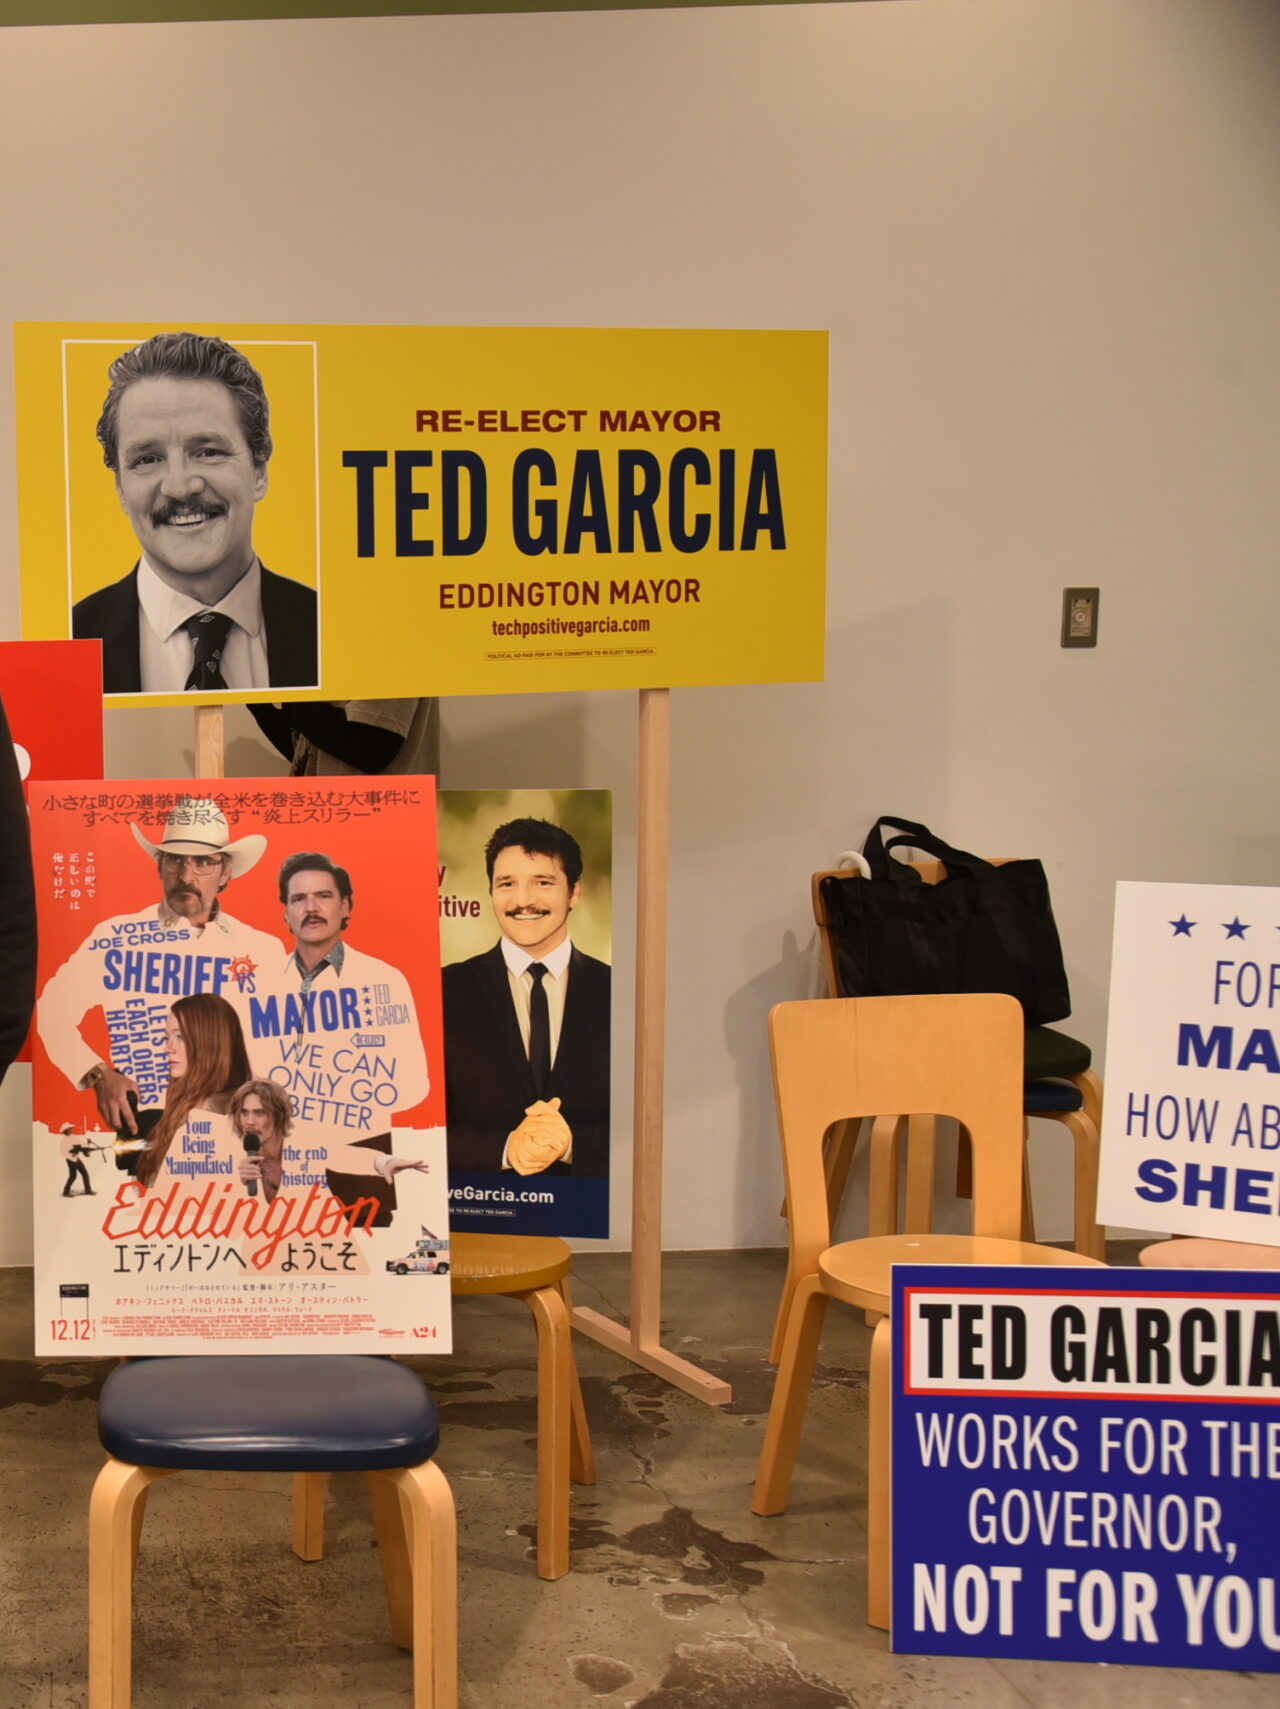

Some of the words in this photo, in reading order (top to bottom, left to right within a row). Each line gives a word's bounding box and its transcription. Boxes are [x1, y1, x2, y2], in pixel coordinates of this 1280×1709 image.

[416, 409, 587, 433] RE-ELECT
[599, 409, 721, 433] MAYOR
[342, 449, 488, 558] TED
[512, 447, 787, 556] GARCIA
[439, 579, 601, 609] EDDINGTON
[610, 578, 701, 605] MAYOR
[492, 616, 650, 639] techpositivegarcia.com
[42, 789, 421, 811] 小さな町の選挙戦が全米を巻き込む大事件に
[69, 853, 81, 910] 正しいのは
[88, 936, 124, 950] JOE
[127, 929, 190, 946] CROSS
[111, 920, 161, 935] VOTE
[103, 949, 231, 996] SHERIFF
[249, 988, 361, 1039] MAYOR
[373, 984, 390, 1005] TED
[125, 998, 148, 1044] EACH
[376, 1004, 410, 1027] GARCIA
[106, 1009, 134, 1075] HEARTS
[280, 1039, 324, 1068] WE
[333, 1049, 396, 1080] CAN
[268, 1066, 342, 1097] ONLY
[350, 1079, 398, 1106] GO
[288, 1095, 372, 1130] BETTER
[1126, 1092, 1220, 1144] HOW
[283, 1145, 300, 1161] the
[305, 1146, 328, 1161] end
[1135, 1158, 1280, 1217] SHE
[101, 1180, 381, 1271] Eddington
[114, 1243, 247, 1273] エディントンへ
[281, 1242, 357, 1272] ようこそ
[50, 1319, 90, 1340] 12.12
[411, 1326, 436, 1338] A24
[919, 1303, 1027, 1380] TED
[1050, 1304, 1280, 1387] GARCIA
[915, 1412, 1079, 1472] WORKS
[1100, 1417, 1188, 1476] FOR
[1201, 1420, 1280, 1479] THE
[969, 1487, 1238, 1564] GOVERNOR,
[913, 1563, 1022, 1636] NOT
[1046, 1567, 1159, 1643] FOR
